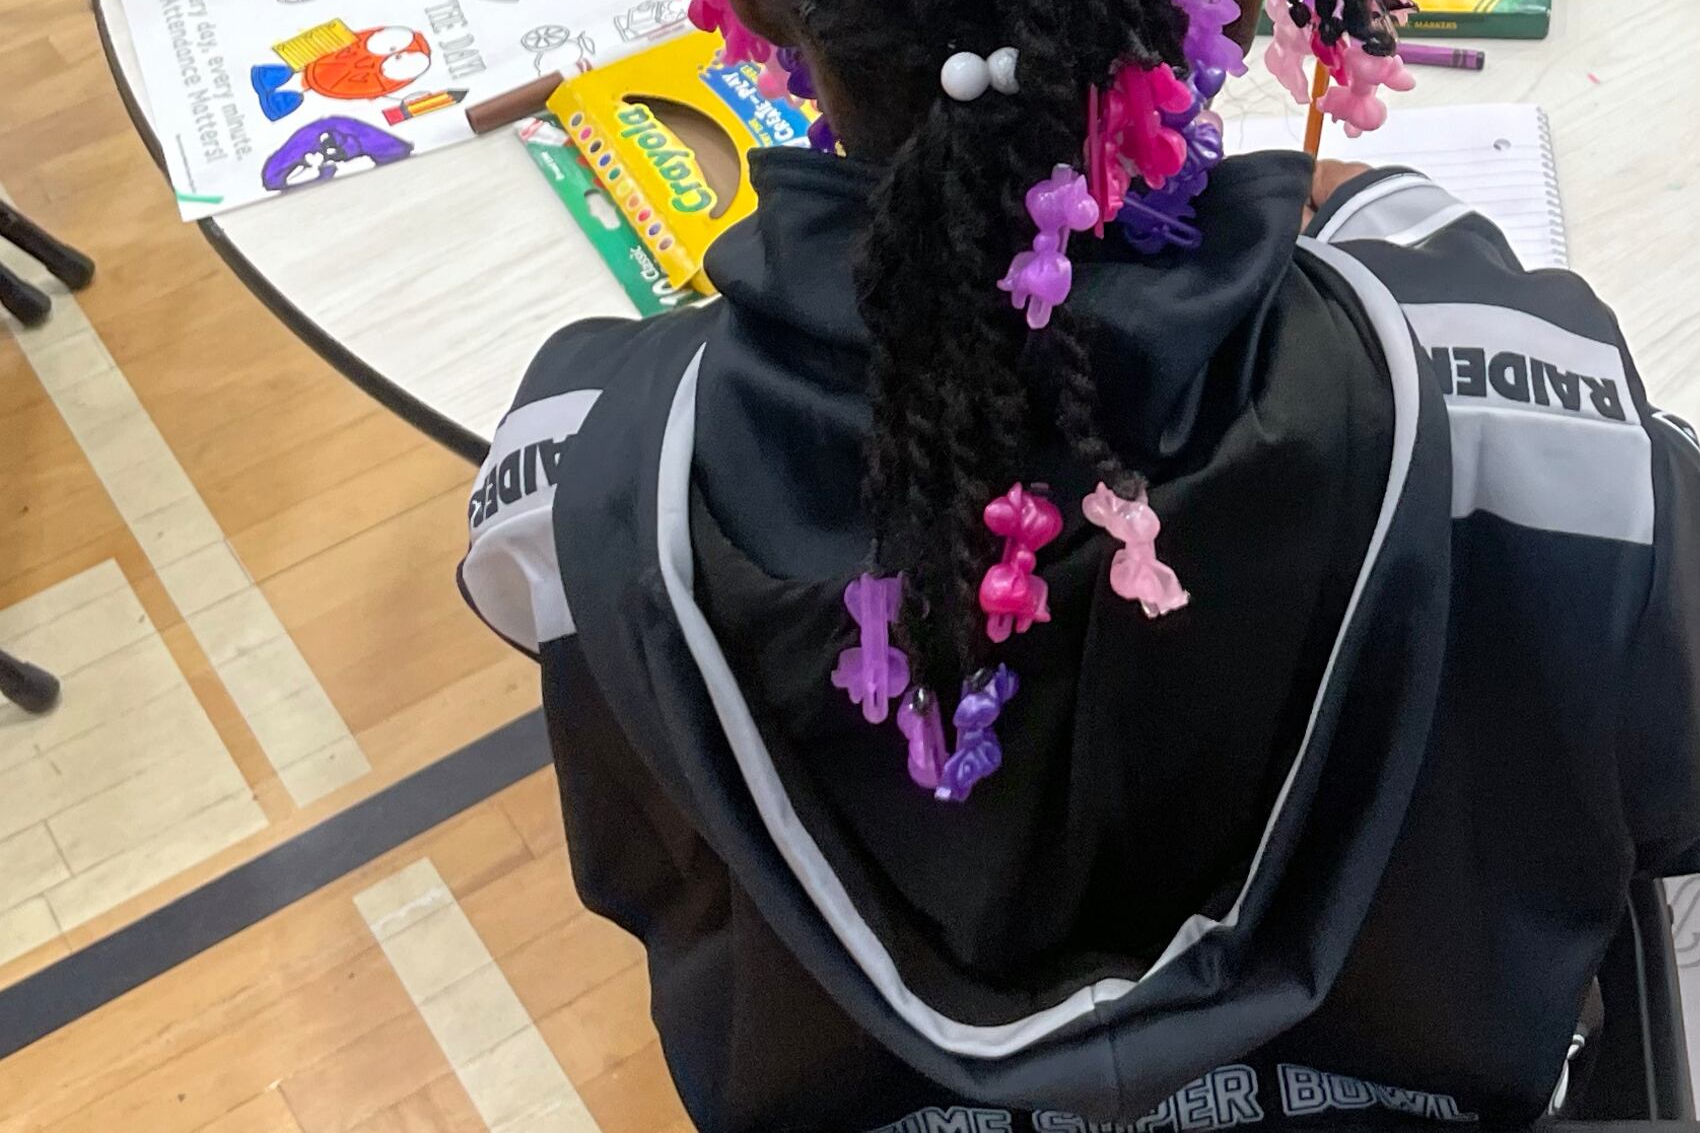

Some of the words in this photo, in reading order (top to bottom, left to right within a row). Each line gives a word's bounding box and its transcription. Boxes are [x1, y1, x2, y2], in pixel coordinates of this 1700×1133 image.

[208, 55, 235, 99] every
[617, 105, 714, 212] Crayola
[1277, 1063, 1480, 1124] BOWL
